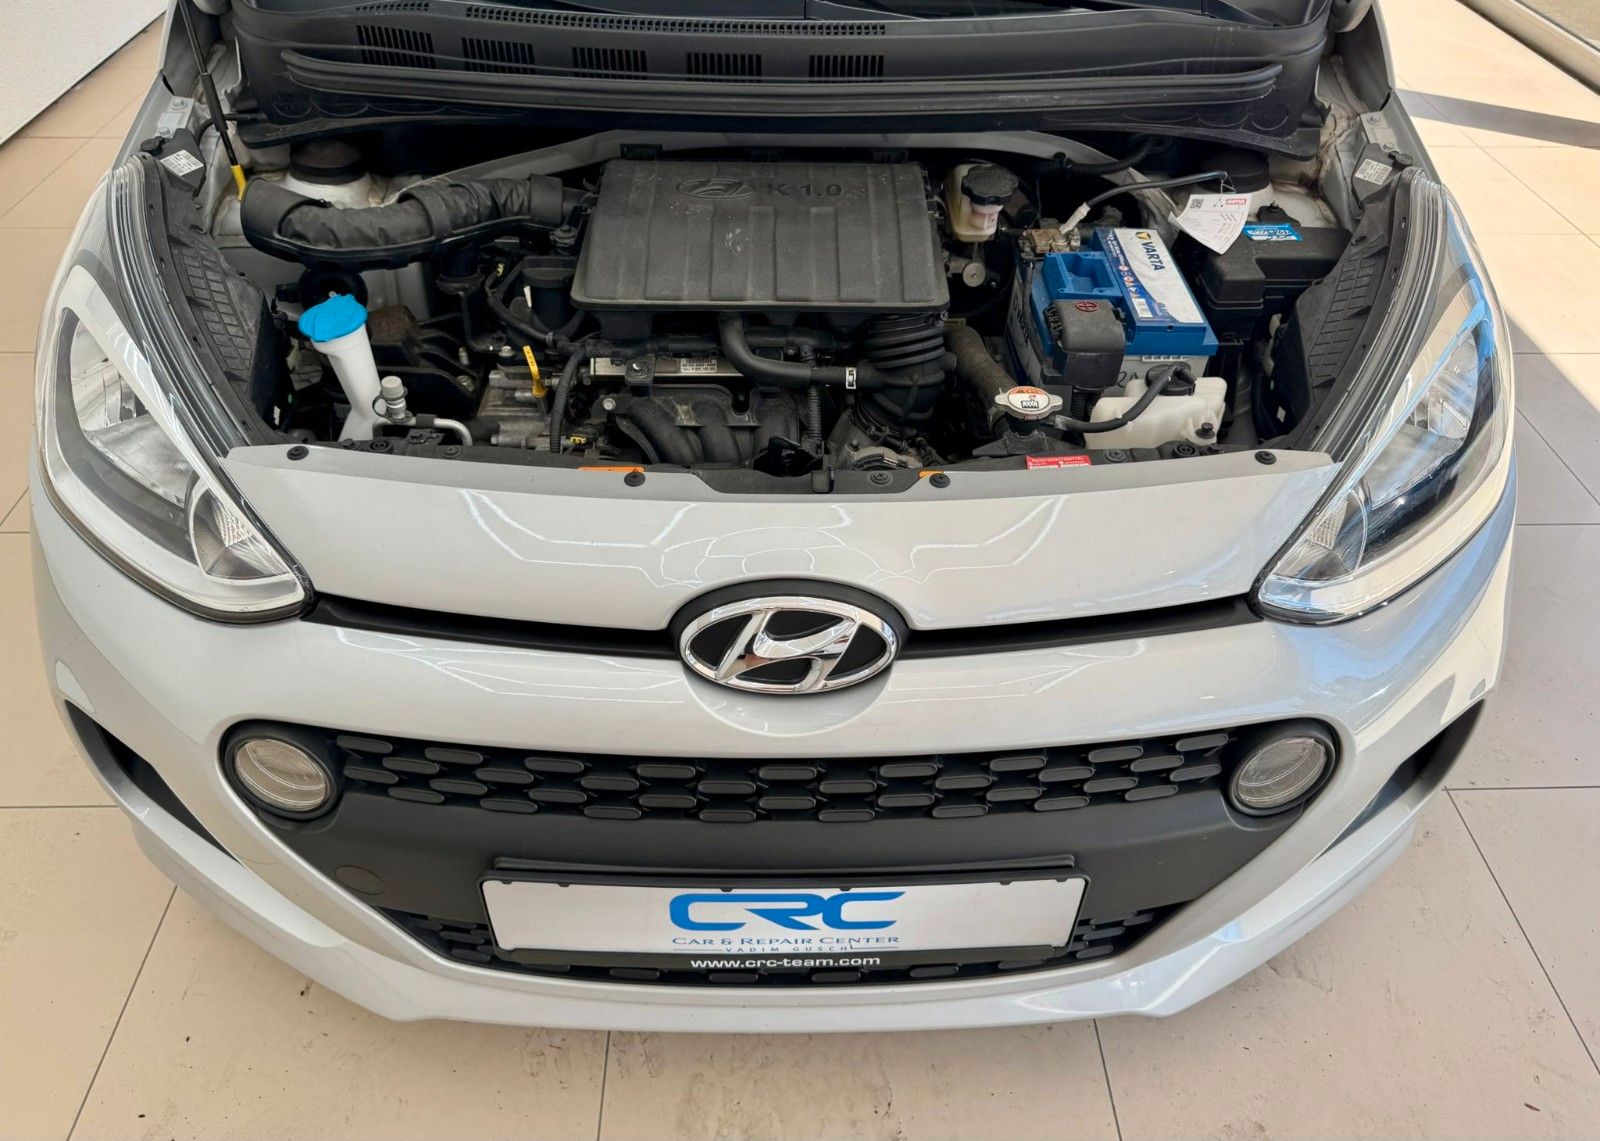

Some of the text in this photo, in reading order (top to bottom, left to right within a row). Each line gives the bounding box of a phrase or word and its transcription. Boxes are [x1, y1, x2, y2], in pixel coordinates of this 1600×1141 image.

[767, 183, 842, 197] K 1.0
[1142, 241, 1166, 271] VARTA
[669, 891, 906, 931] CRC
[721, 937, 732, 945] &
[690, 956, 881, 968] www.crc-team.com
